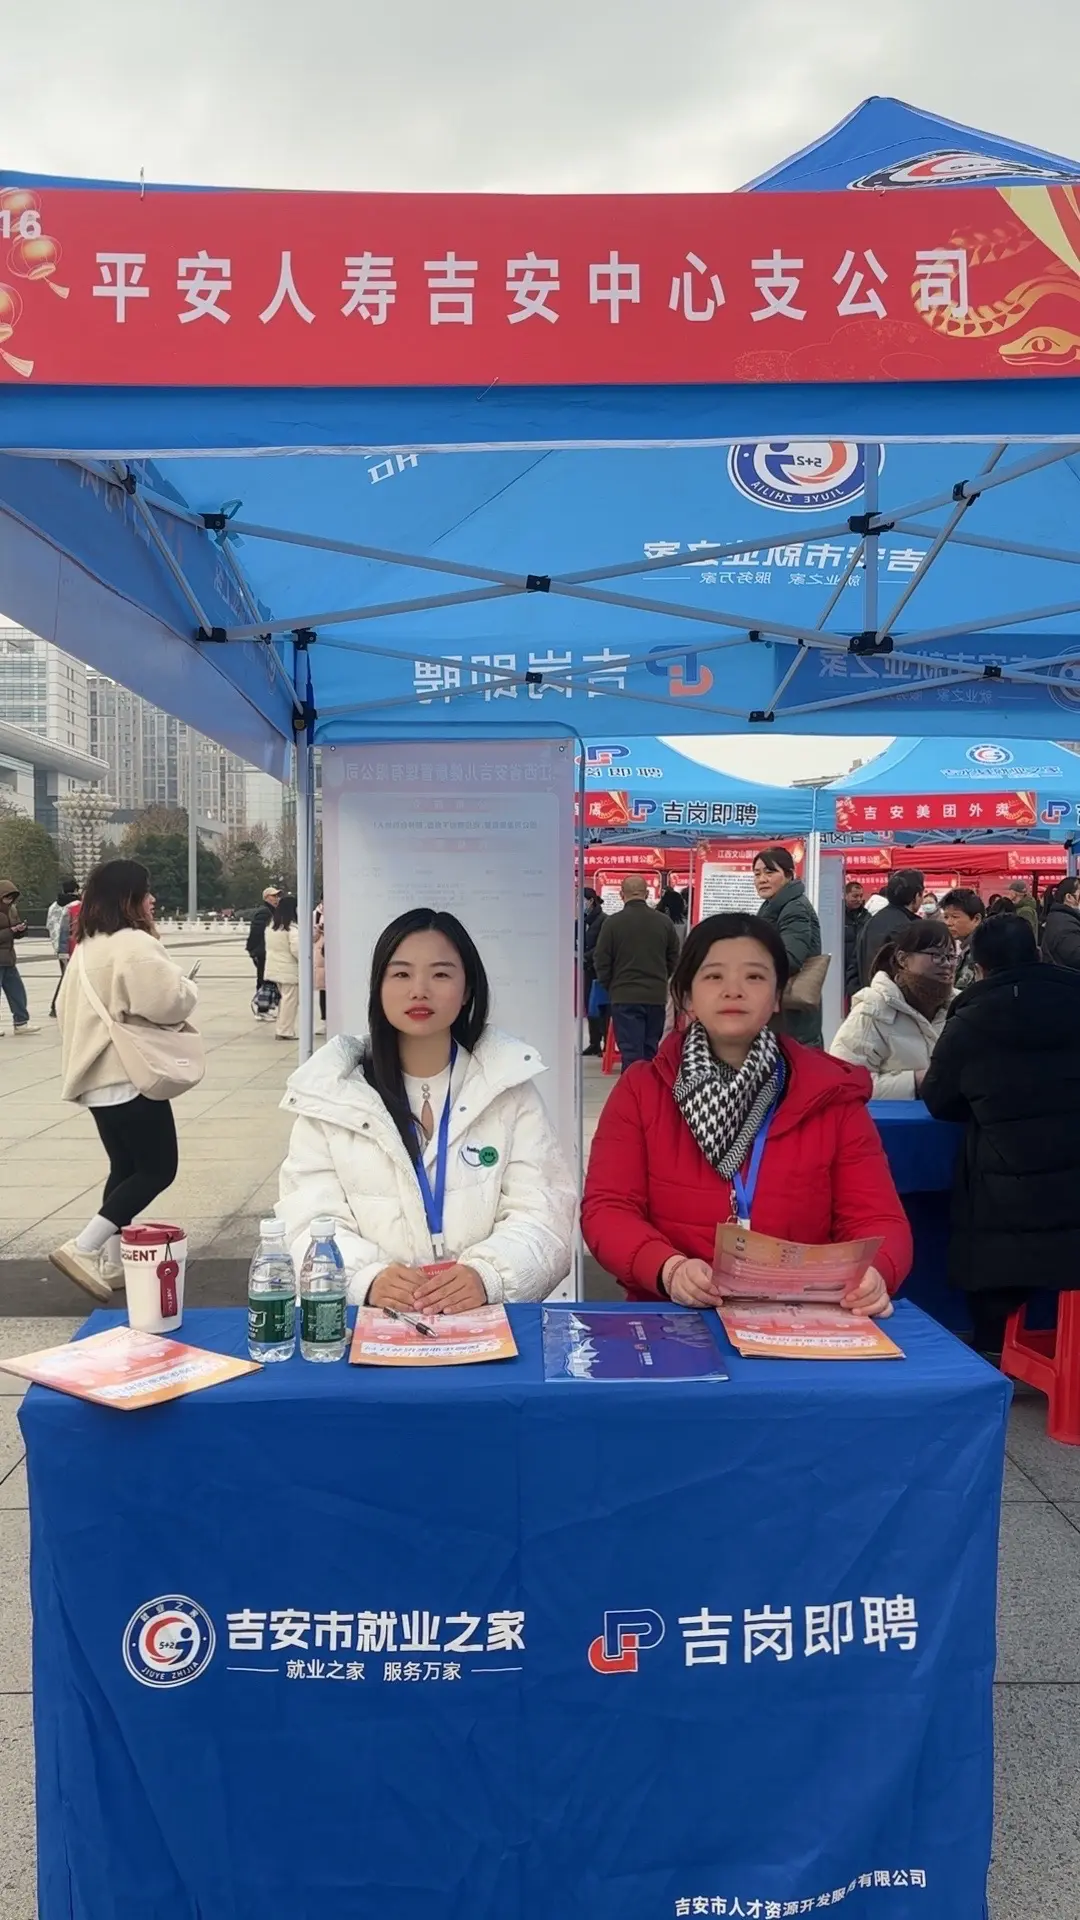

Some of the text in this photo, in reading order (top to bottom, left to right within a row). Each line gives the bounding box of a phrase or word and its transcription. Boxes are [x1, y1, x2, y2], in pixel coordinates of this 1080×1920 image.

[92, 248, 969, 325] 平安人寿吉安中心支公司
[662, 800, 758, 826] 吉岗即聘
[863, 802, 1010, 821] 吉安美团外卖
[226, 1608, 526, 1653] 吉安市就业之家
[678, 1593, 919, 1666] 吉岗即聘
[141, 1661, 199, 1680] JIUYE ZHIJIA
[285, 1659, 462, 1682] 就业之家 服务万家
